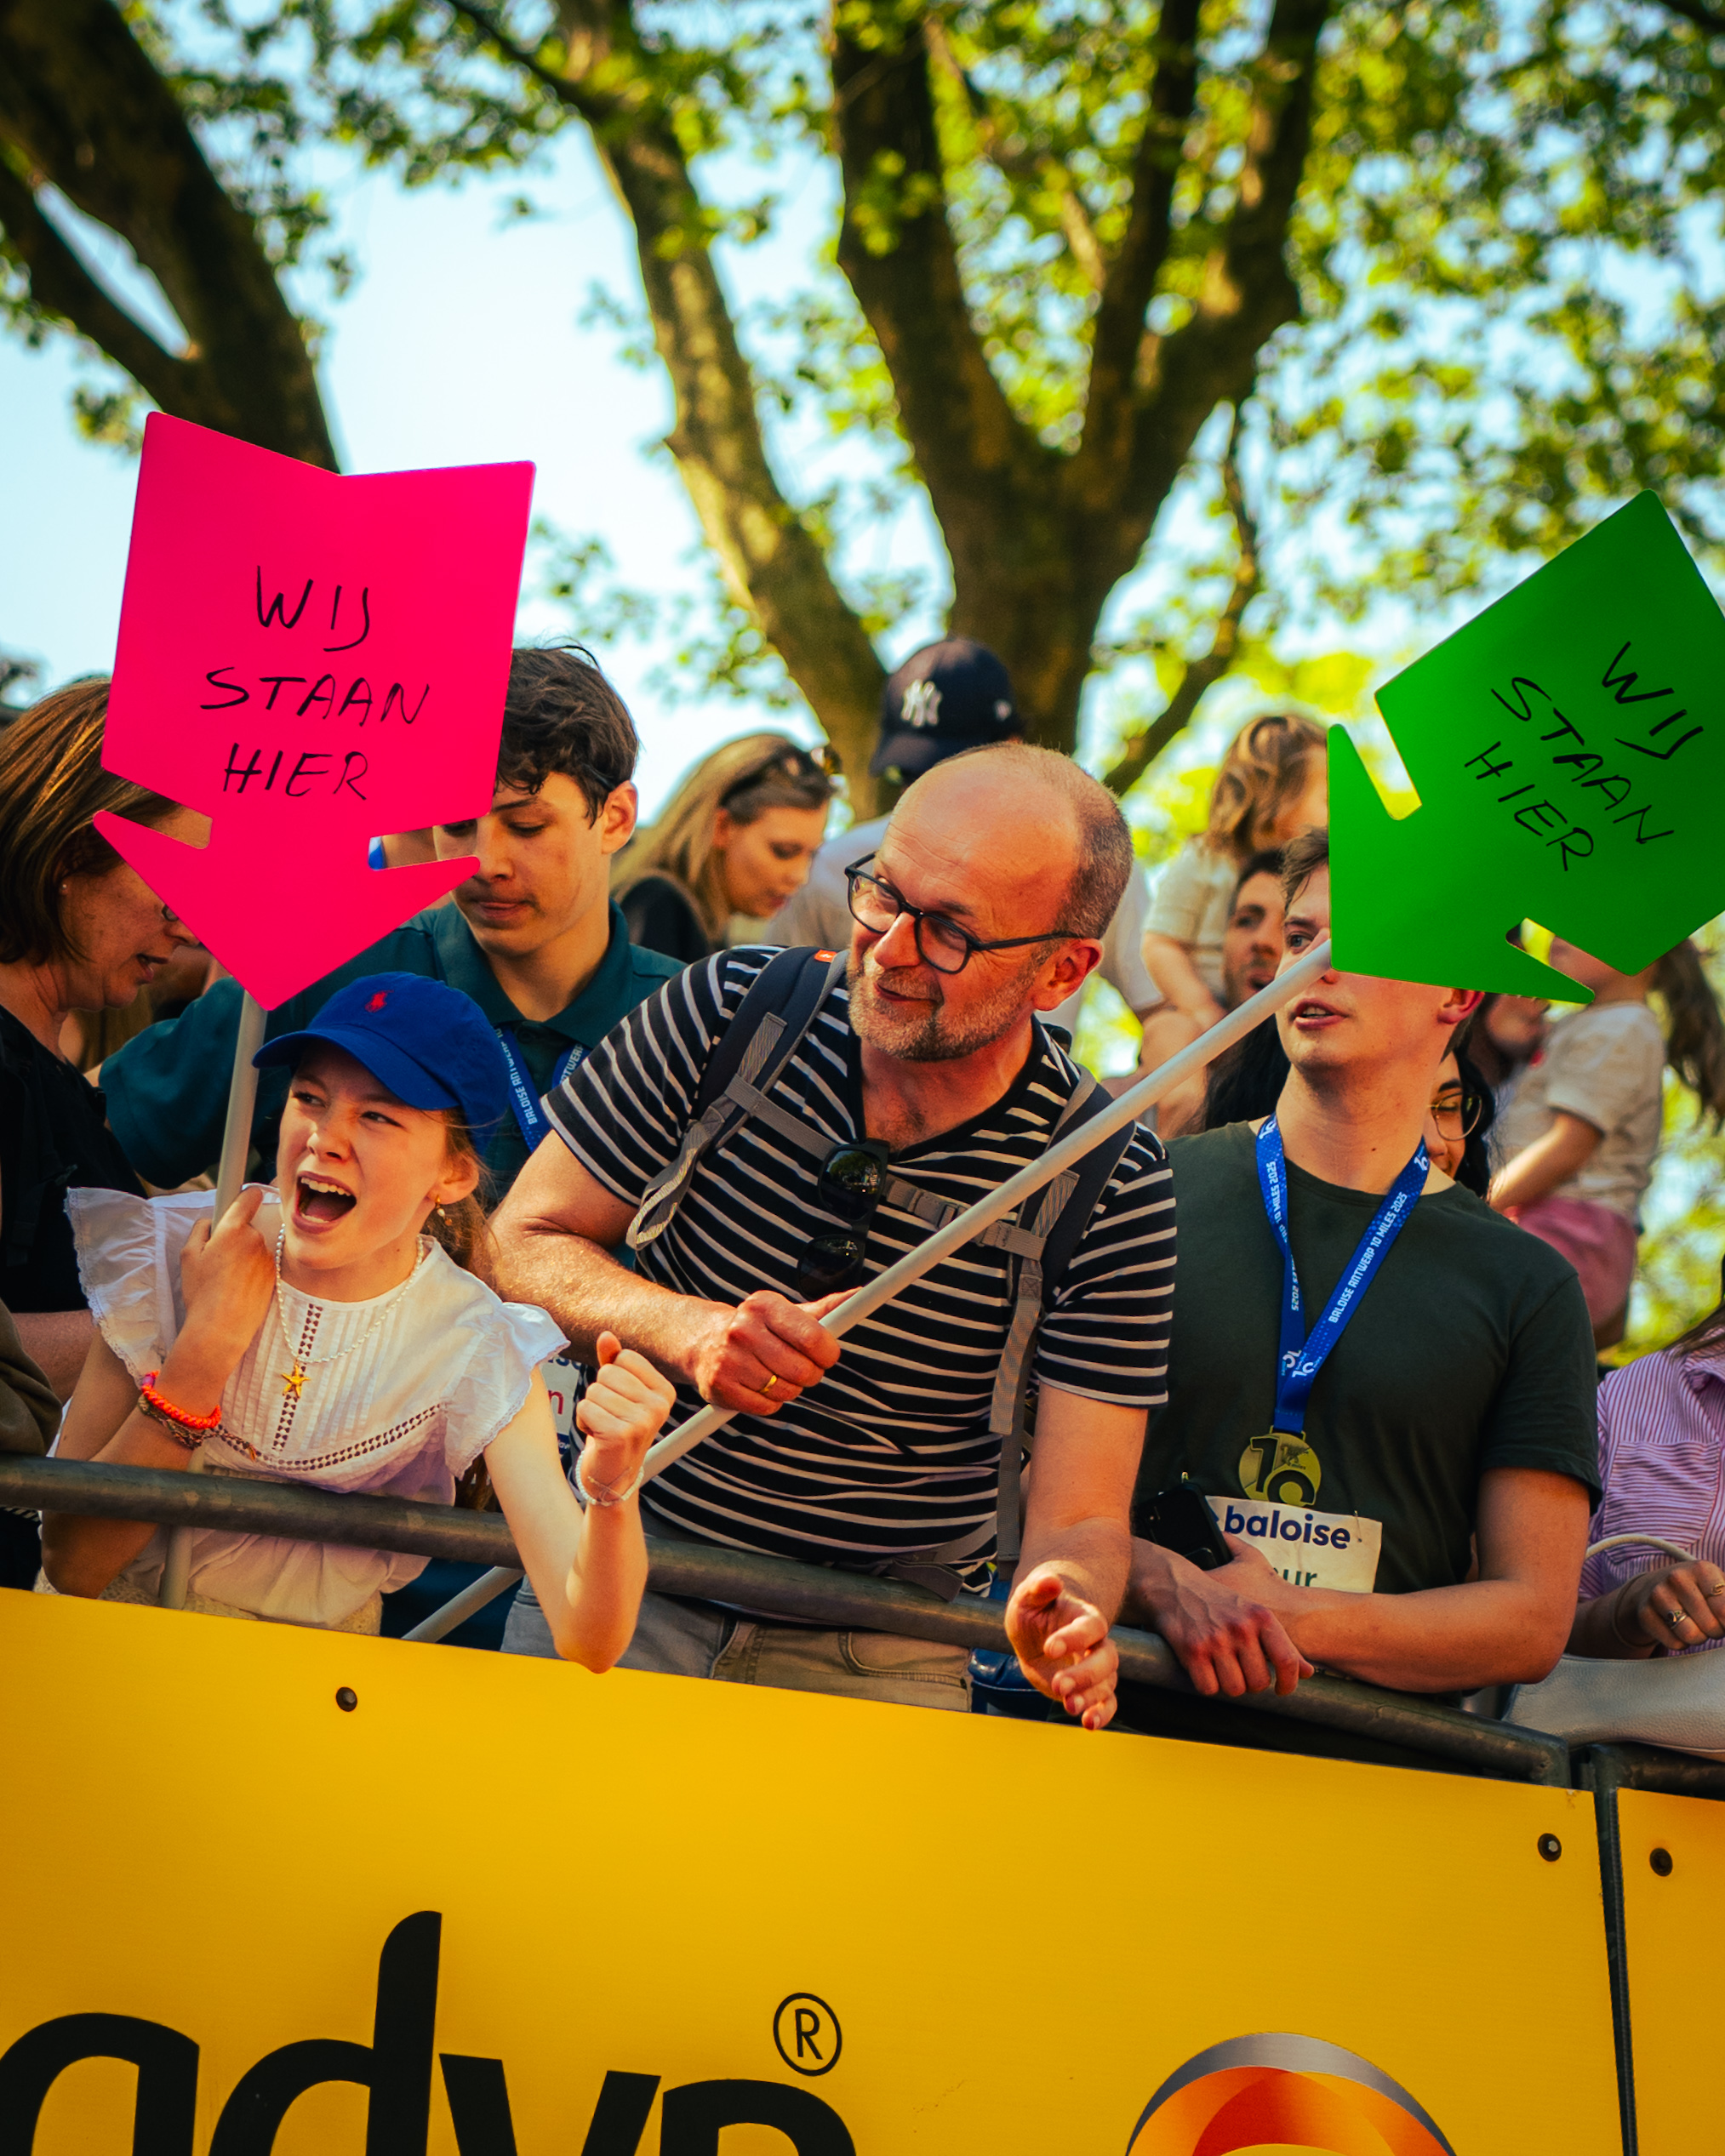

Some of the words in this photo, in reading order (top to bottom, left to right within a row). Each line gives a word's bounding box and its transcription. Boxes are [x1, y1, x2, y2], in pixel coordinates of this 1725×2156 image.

[257, 565, 369, 652] WIJ
[200, 666, 430, 727] STAAN
[1602, 641, 1703, 760] WIJ
[223, 743, 368, 801] HIER
[1490, 677, 1675, 844] STAAN
[1464, 741, 1594, 871] HIER
[515, 1086, 538, 1125] BALOISE
[1266, 1161, 1278, 1184] 2025
[1271, 1184, 1282, 1212] MILES
[1328, 1286, 1355, 1323] BALOISE
[1348, 1246, 1375, 1289] ANTWERP
[1370, 1235, 1382, 1248] 10
[1376, 1211, 1397, 1238] MILES
[1391, 1191, 1408, 1213] 2025
[1224, 1505, 1351, 1549] baloise
